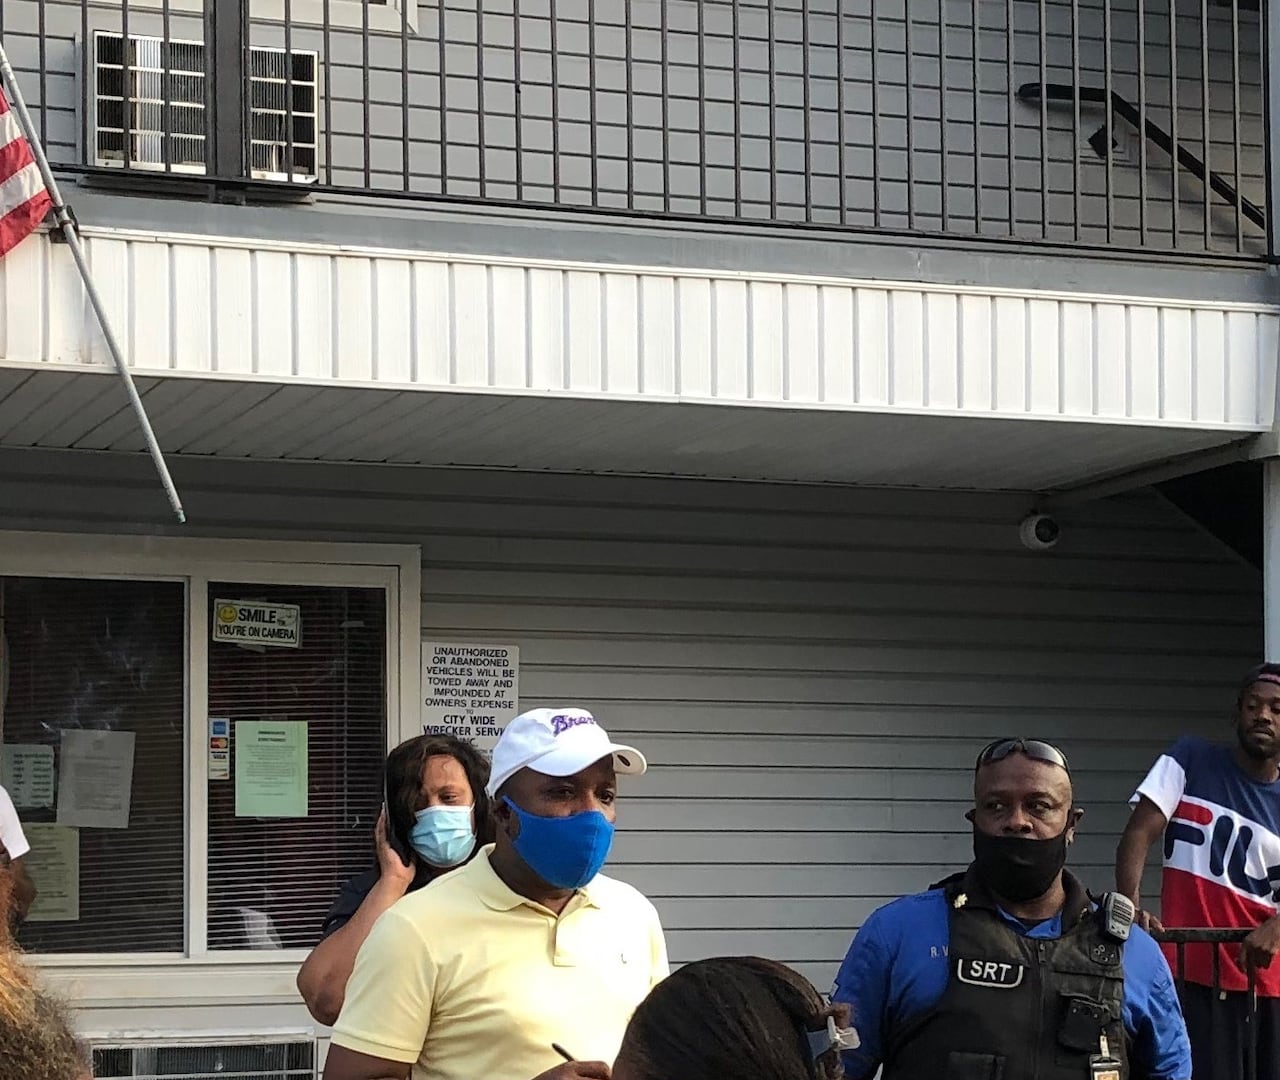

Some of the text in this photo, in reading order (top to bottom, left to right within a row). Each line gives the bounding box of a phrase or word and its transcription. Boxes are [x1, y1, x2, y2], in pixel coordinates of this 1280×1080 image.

[238, 608, 277, 623] SMILE
[218, 624, 295, 640] YOU'RE ON CAMERA
[434, 647, 508, 658] UNAUTHORIZED
[432, 656, 509, 667] OR ABANDONED
[426, 666, 515, 678] VEHICLES WILL BE
[427, 677, 513, 688] TOWED AWAY AND
[434, 688, 505, 698] IMPOUNDED AT
[425, 698, 514, 709] OWNERS EXPENSE
[443, 714, 495, 725] CITY WIDE
[423, 725, 505, 737] WRECKER SERVI
[970, 960, 1012, 981] SRT
